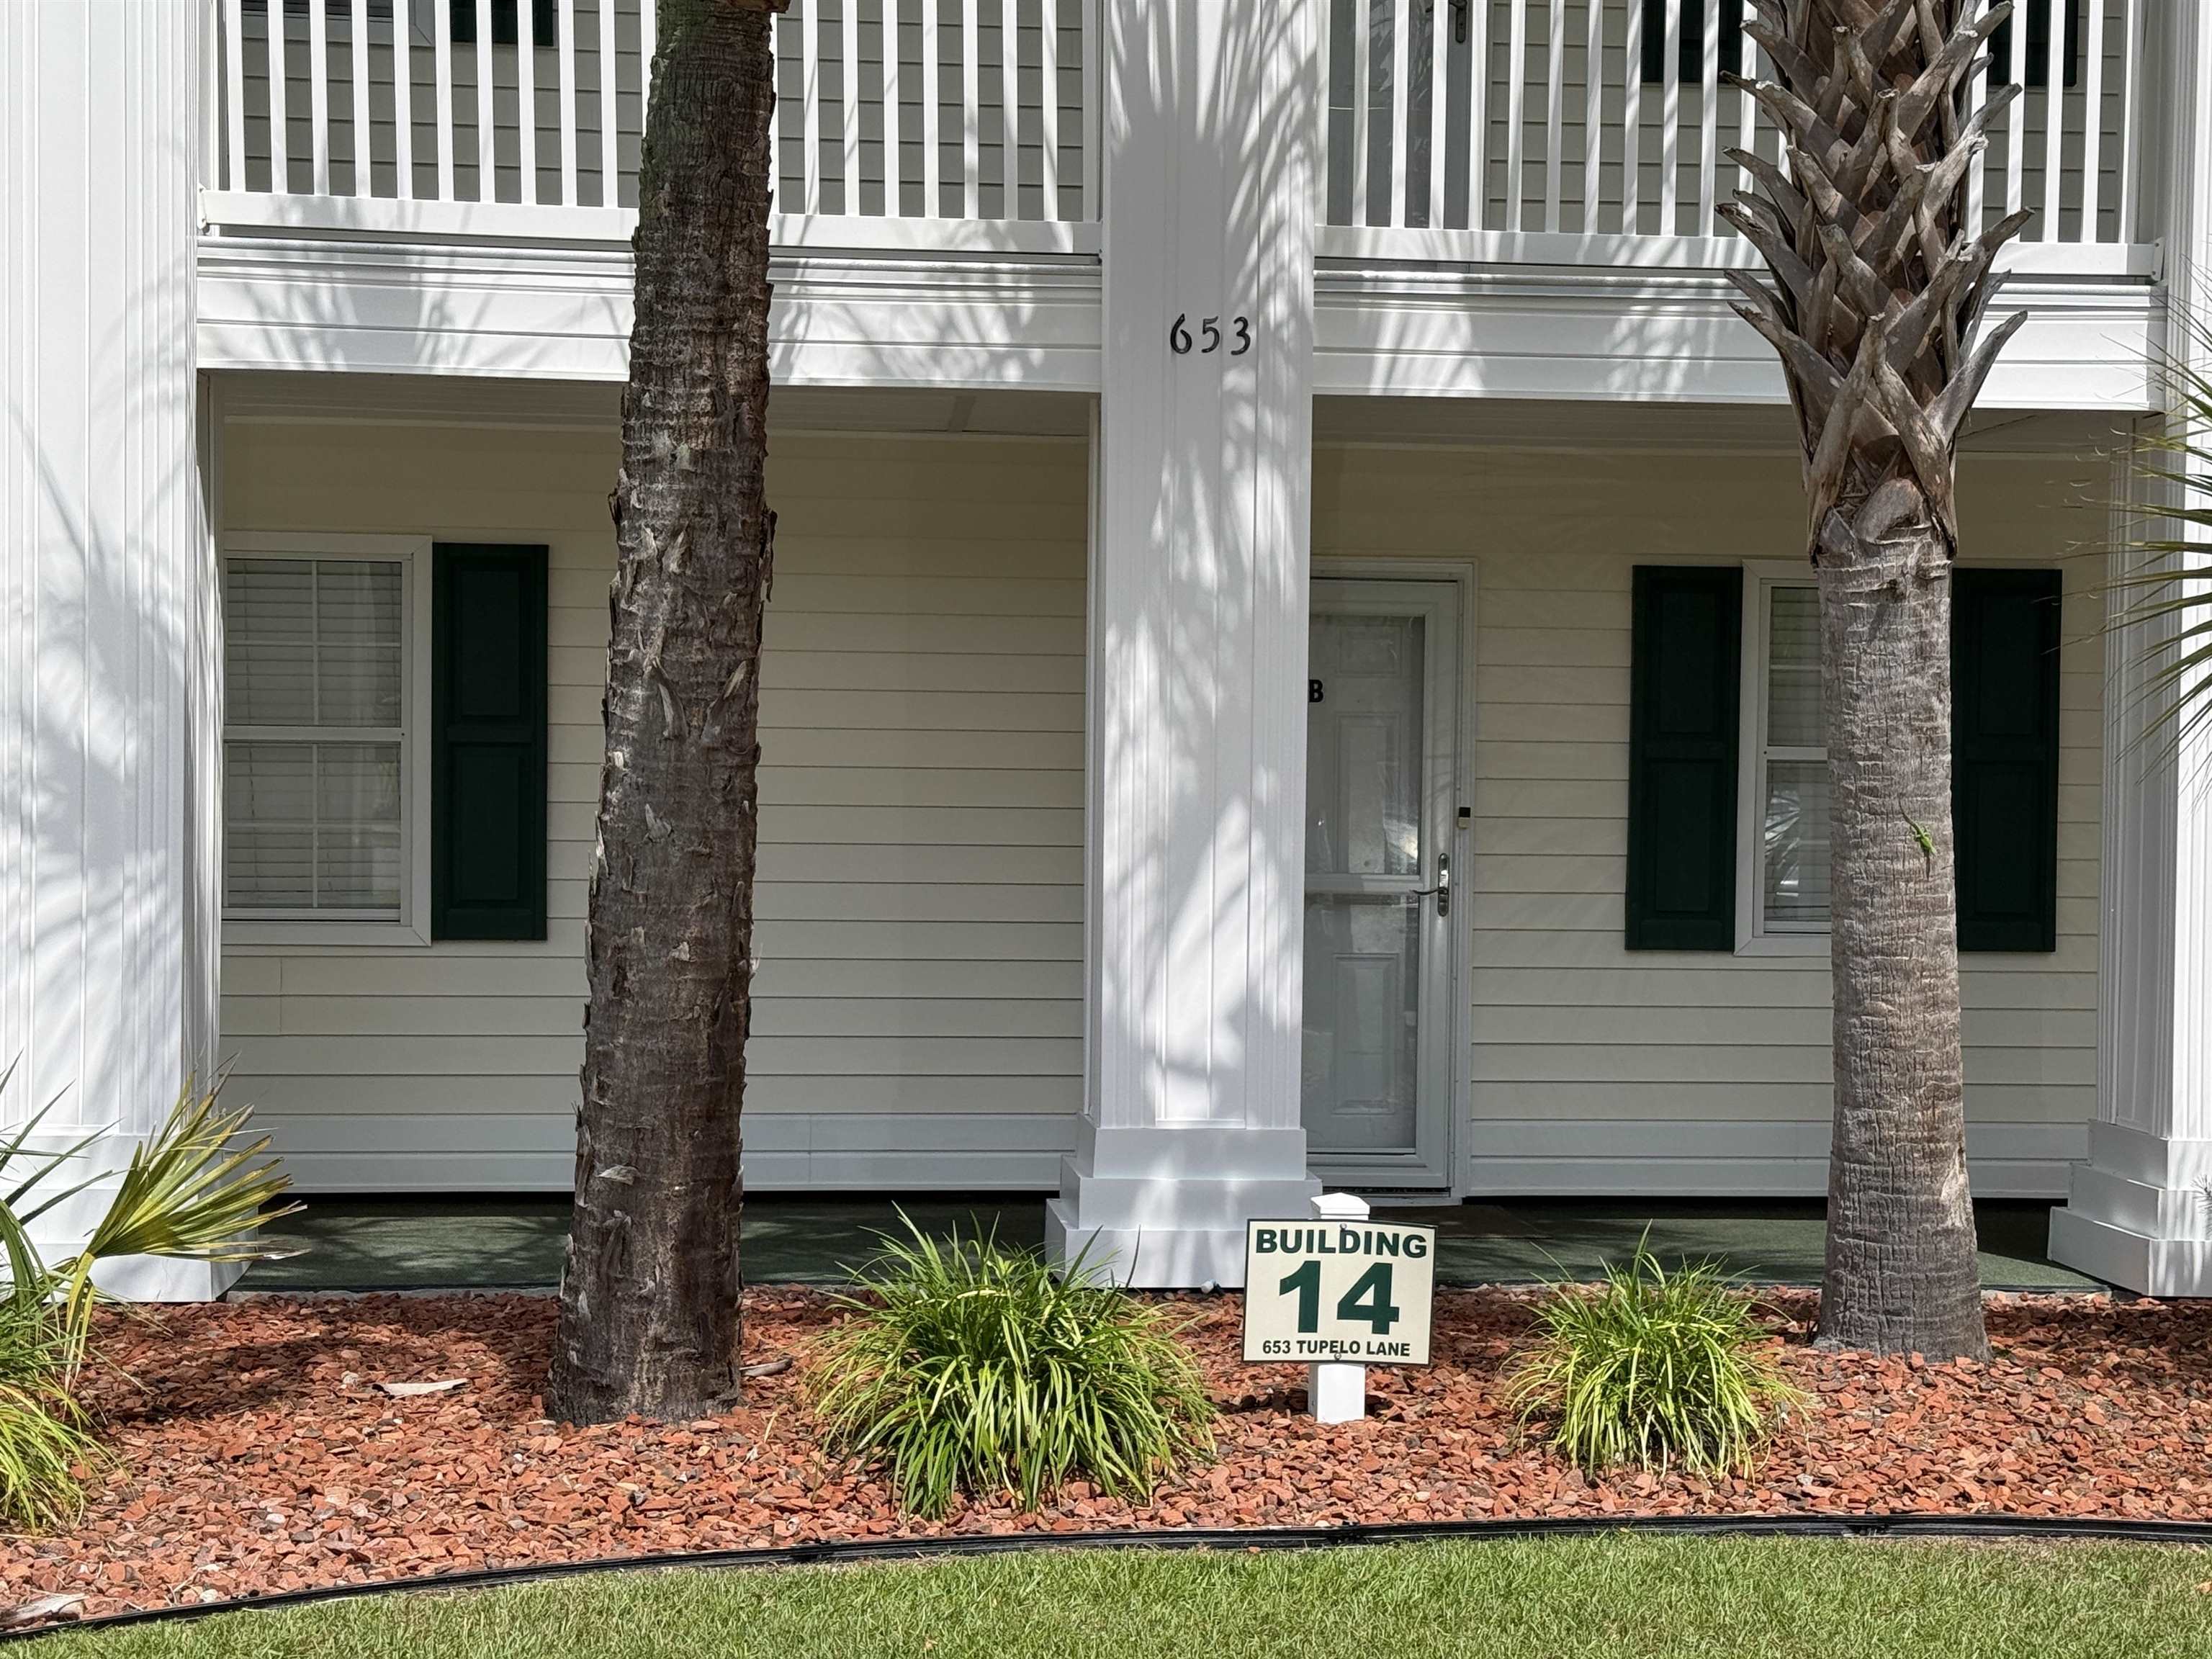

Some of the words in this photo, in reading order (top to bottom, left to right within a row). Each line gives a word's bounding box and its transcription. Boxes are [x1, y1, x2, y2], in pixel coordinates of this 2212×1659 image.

[1170, 313, 1251, 356] 653
[1308, 679, 1324, 703] B
[1256, 1229, 1426, 1258] BUILDING
[1279, 1260, 1400, 1335] 14
[1262, 1340, 1291, 1354] 653
[1297, 1340, 1360, 1354] TUPELO
[1366, 1341, 1411, 1357] LANE
